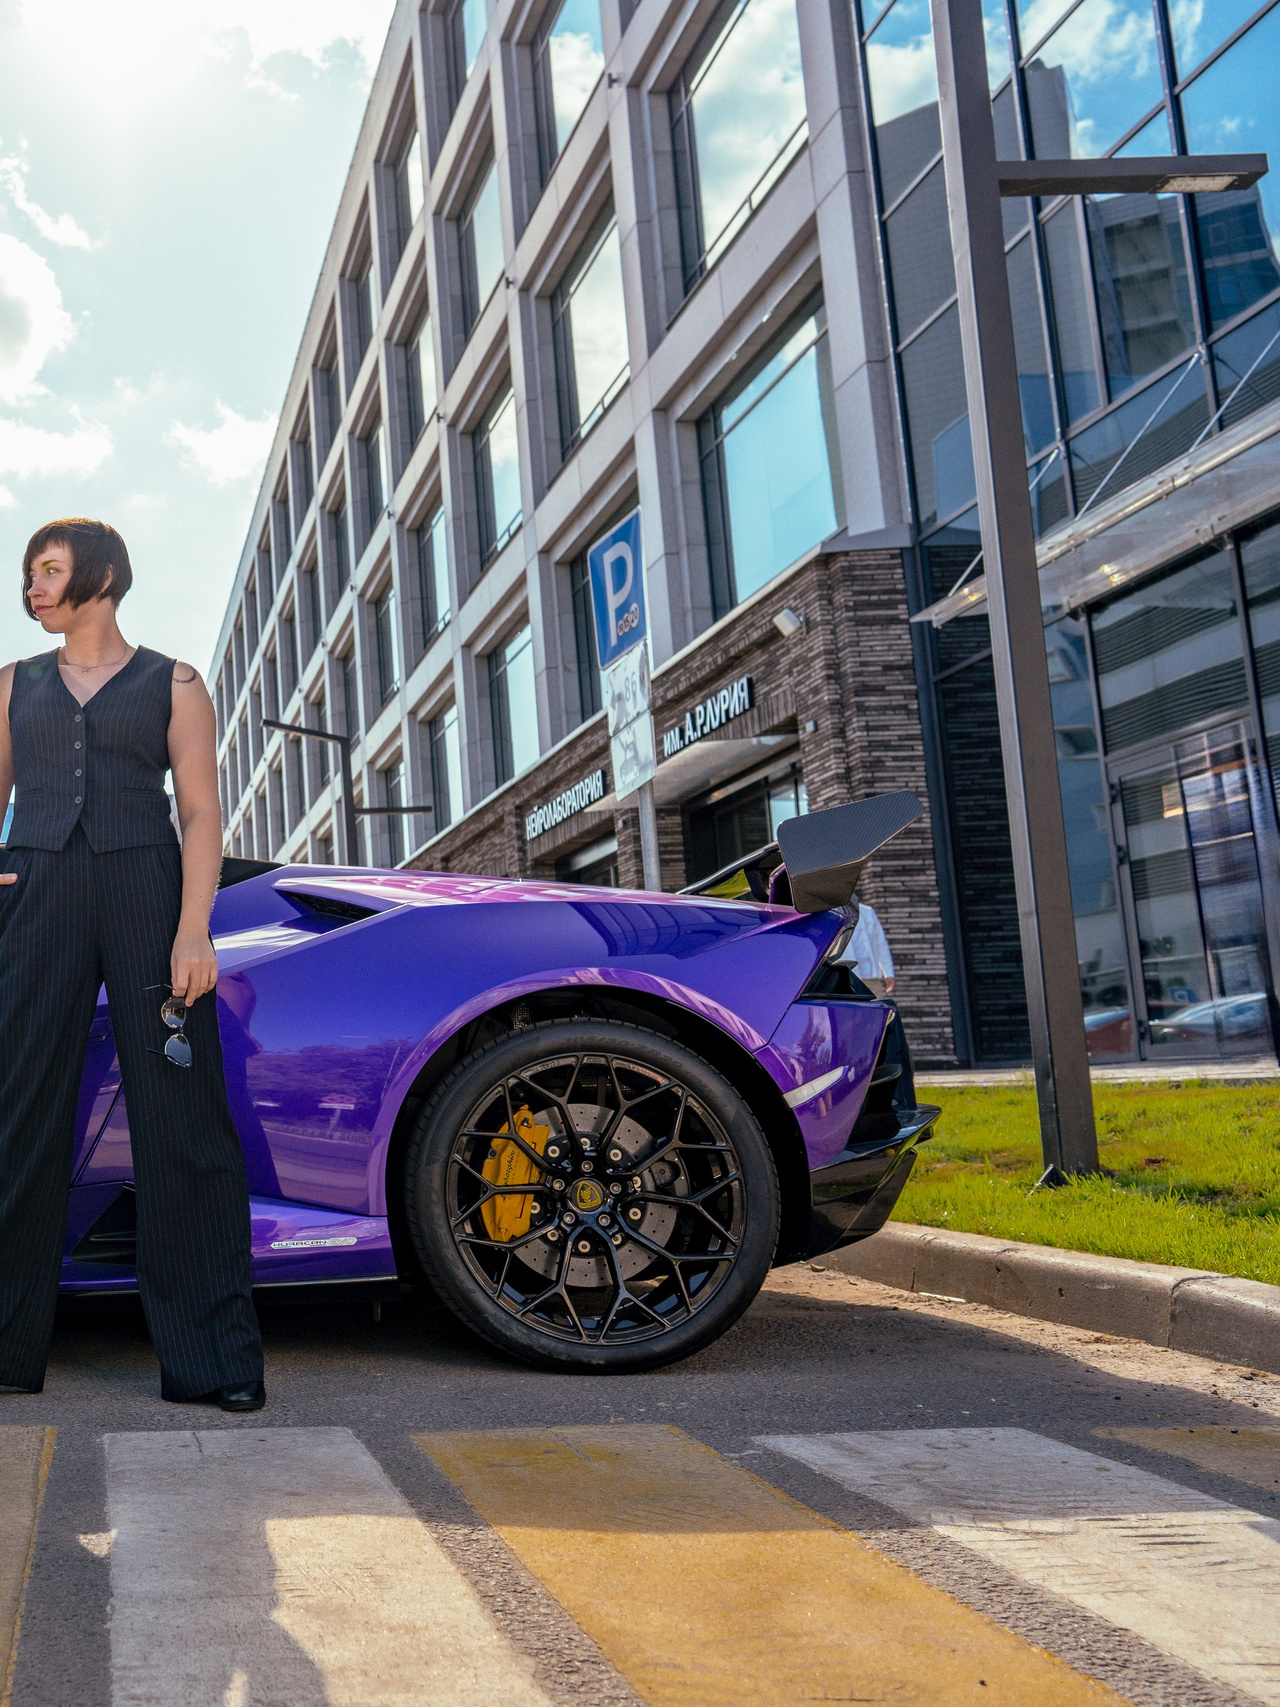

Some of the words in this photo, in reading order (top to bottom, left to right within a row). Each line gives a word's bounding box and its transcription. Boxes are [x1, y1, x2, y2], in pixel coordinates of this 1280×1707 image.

[603, 541, 634, 647] P
[663, 726, 684, 758] ИМ.
[525, 769, 603, 841] НЕЙРОЛАБОРАТОРИЯ
